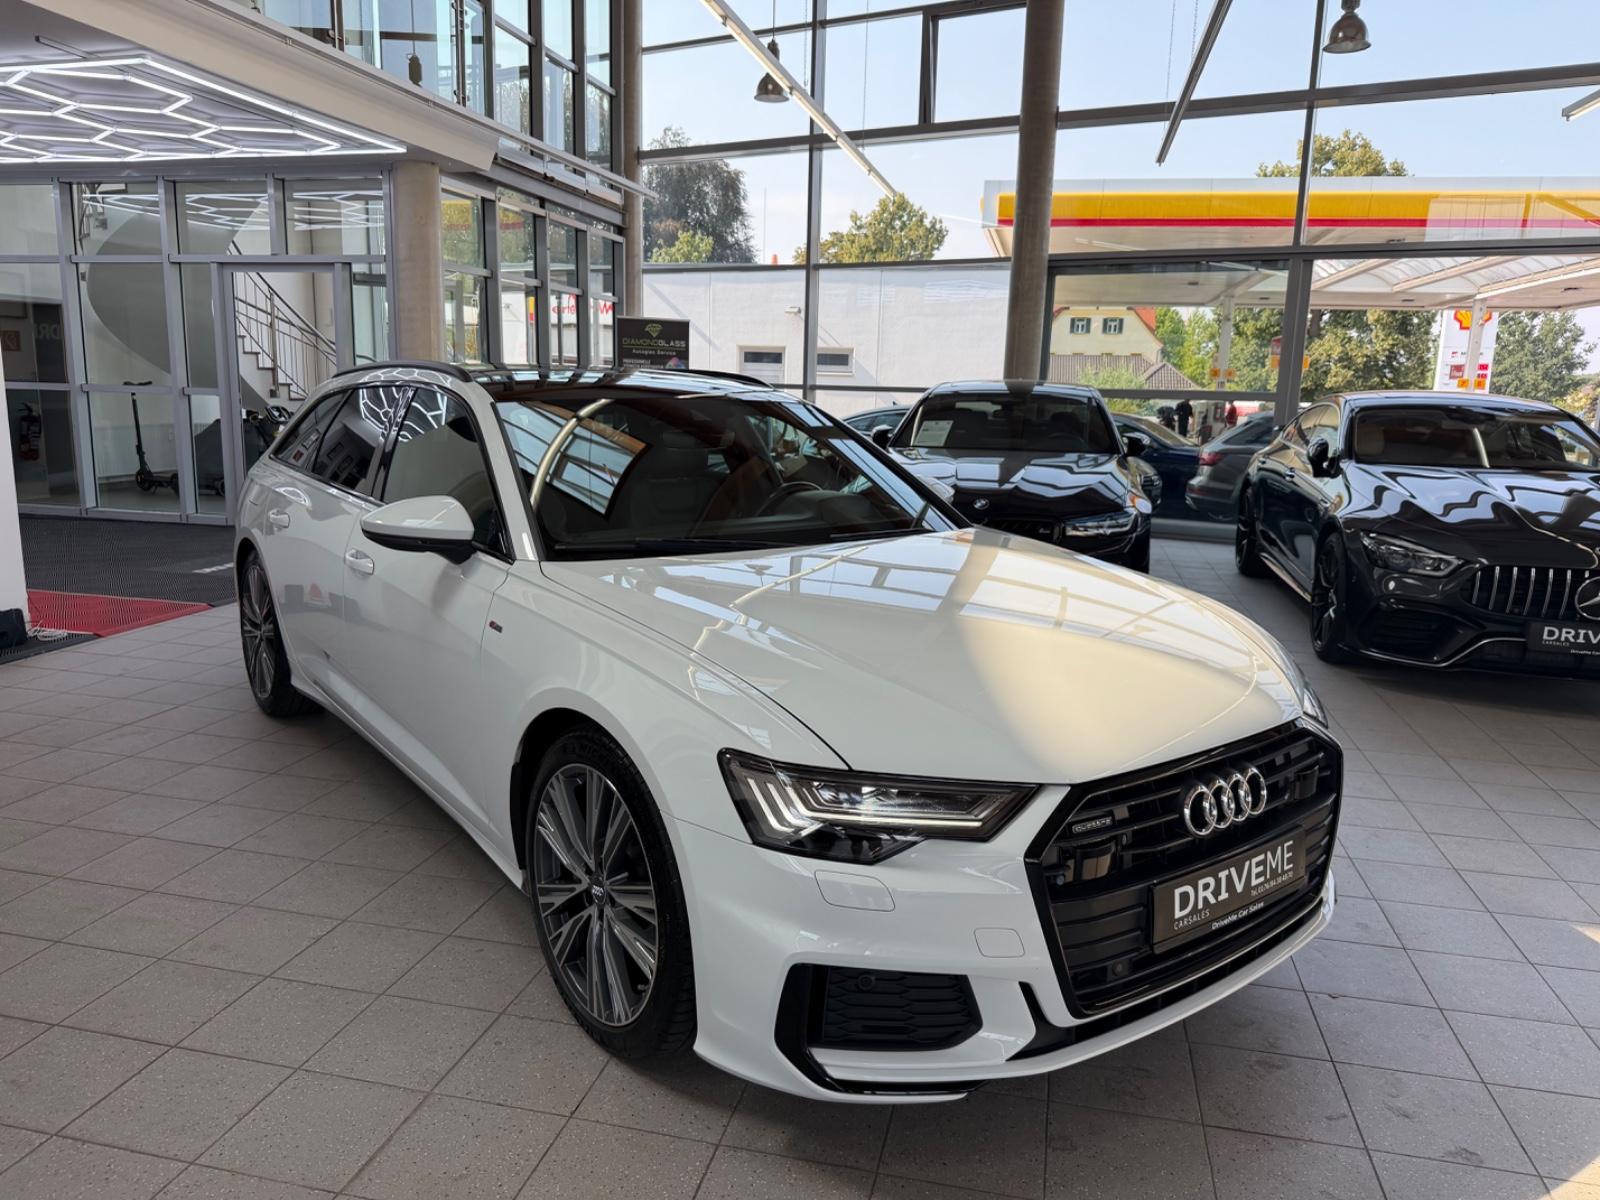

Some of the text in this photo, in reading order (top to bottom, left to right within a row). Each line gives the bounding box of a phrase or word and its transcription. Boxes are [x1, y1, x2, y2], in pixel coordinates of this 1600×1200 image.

[1174, 840, 1294, 920] DRIVEME
[1173, 909, 1210, 931] CARSALES
[1211, 901, 1265, 931] DriveMe Car Sales
